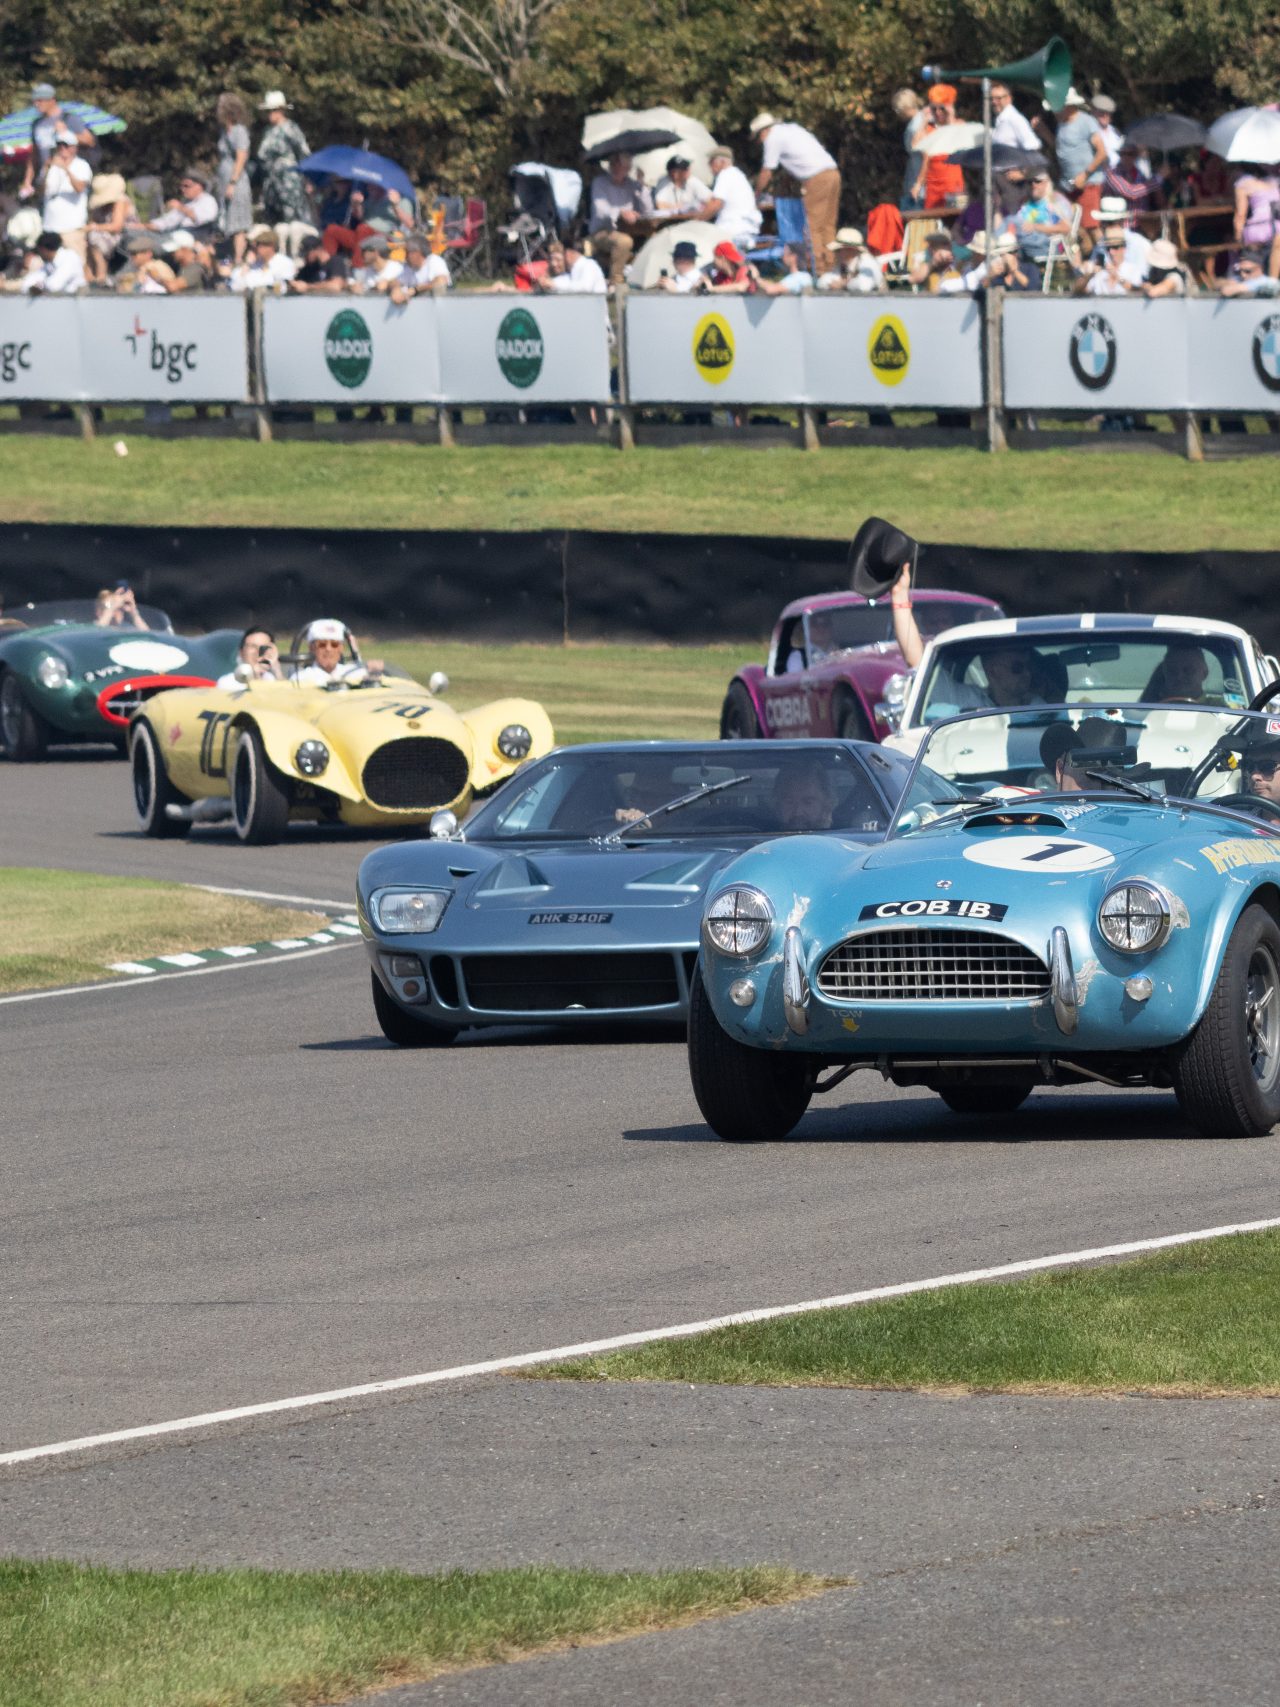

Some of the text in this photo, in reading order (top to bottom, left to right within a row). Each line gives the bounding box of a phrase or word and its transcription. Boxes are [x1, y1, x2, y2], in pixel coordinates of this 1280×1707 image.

[1072, 314, 1116, 341] BMW
[151, 328, 198, 383] bgc
[697, 348, 731, 362] LOTUS
[765, 696, 813, 727] COBRA
[1021, 844, 1089, 861] 1
[875, 900, 951, 918] COB
[531, 913, 609, 925] AHK 940F
[826, 1008, 863, 1019] TOW
